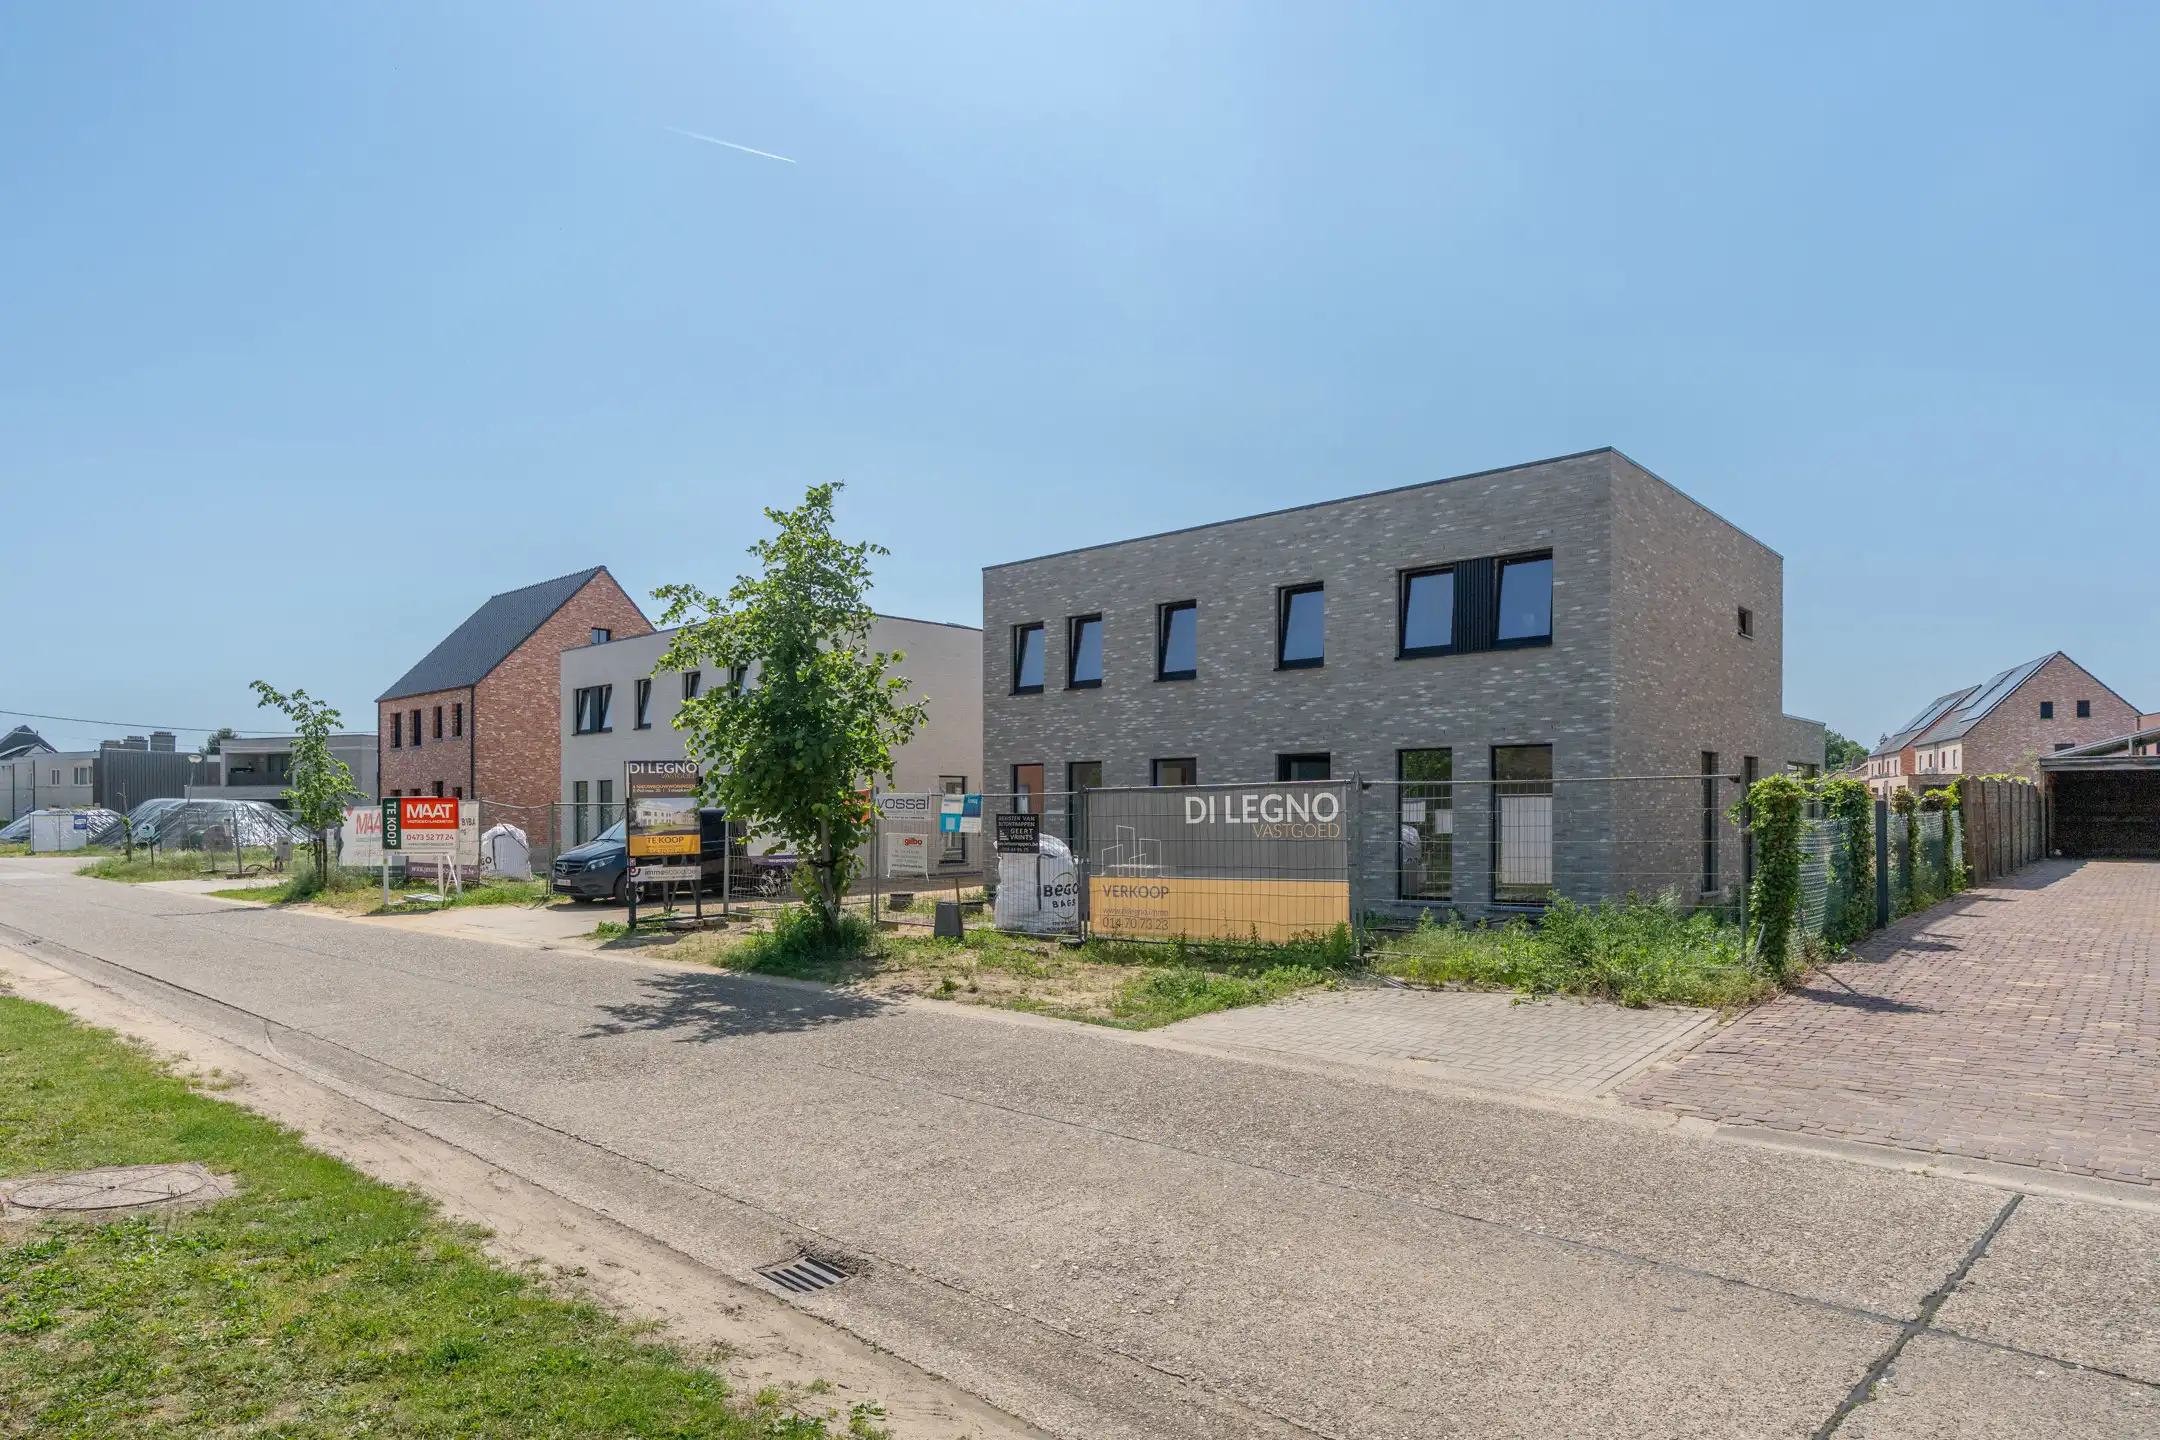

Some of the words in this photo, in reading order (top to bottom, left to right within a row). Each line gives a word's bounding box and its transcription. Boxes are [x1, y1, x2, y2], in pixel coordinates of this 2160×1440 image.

[629, 762, 645, 774] DI
[648, 762, 697, 774] LEGNO
[386, 801, 397, 815] TE
[406, 803, 454, 819] MAAT
[1185, 795, 1215, 824] DI
[1225, 792, 1339, 823] LEGNO
[386, 817, 397, 846] KOOP
[1252, 823, 1340, 838] VASTGOED
[647, 836, 657, 844] TE
[658, 836, 685, 844] KOOP
[1103, 884, 1169, 899] VERKOOP
[1102, 917, 1122, 929] 014
[1124, 917, 1137, 929] 70
[1139, 918, 1153, 930] 73
[1155, 919, 1169, 931] 23
